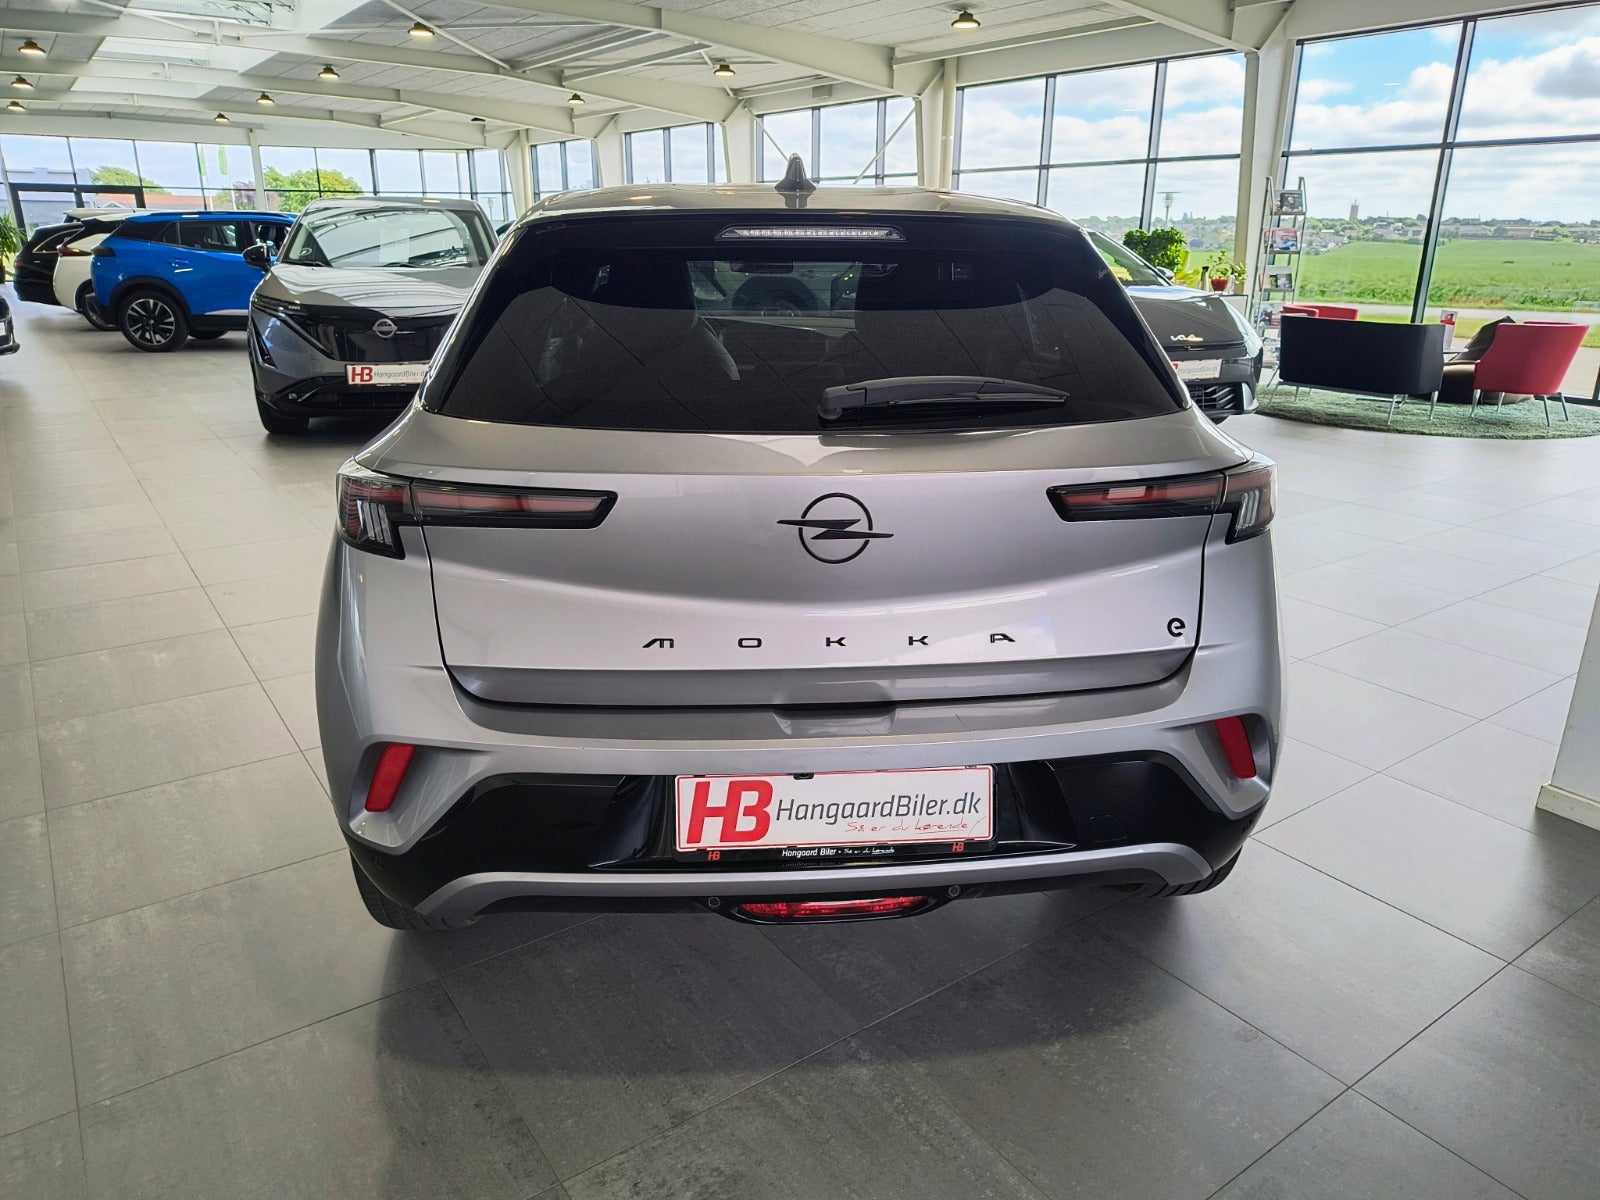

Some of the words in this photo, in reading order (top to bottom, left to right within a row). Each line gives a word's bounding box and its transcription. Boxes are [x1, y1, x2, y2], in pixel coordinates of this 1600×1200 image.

[351, 366, 373, 382] HB
[374, 370, 428, 378] HangaardBiler.d
[1167, 617, 1186, 638] e
[642, 632, 1016, 649] MOKKA
[686, 780, 773, 844] HB
[776, 791, 981, 825] HangaardBiler.dk
[707, 850, 721, 861] HB
[781, 848, 818, 858] Hangaard
[820, 848, 837, 856] Biler
[952, 842, 965, 853] HB
